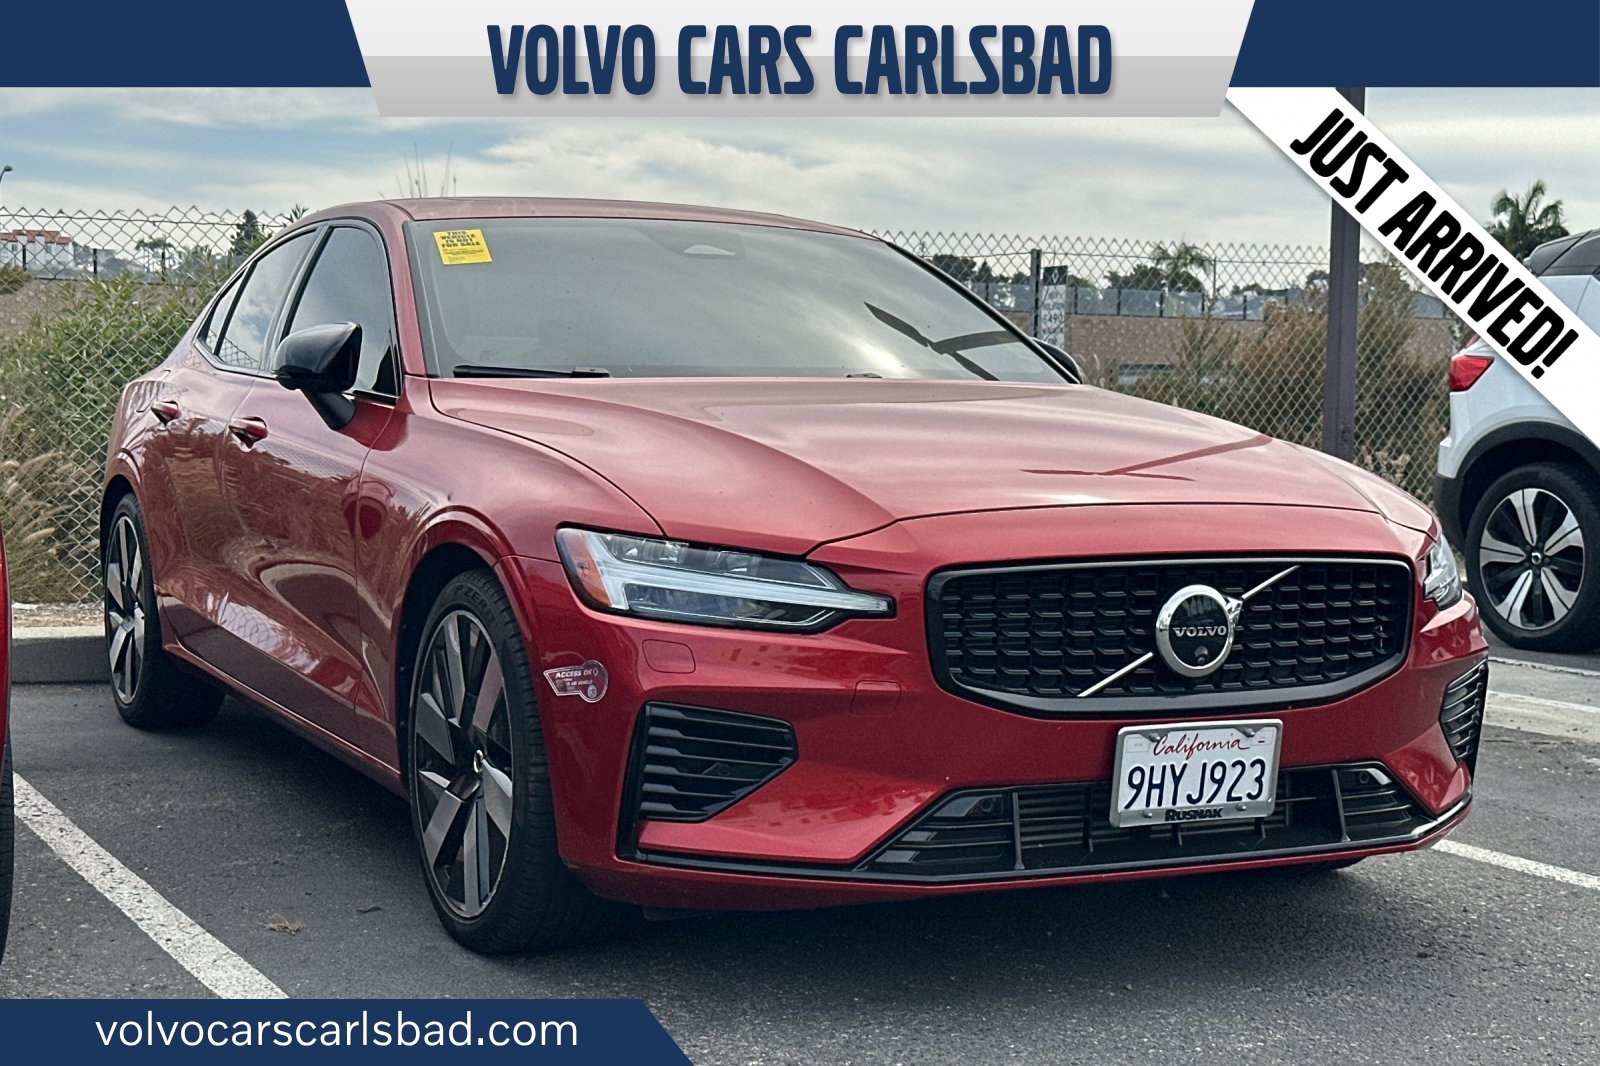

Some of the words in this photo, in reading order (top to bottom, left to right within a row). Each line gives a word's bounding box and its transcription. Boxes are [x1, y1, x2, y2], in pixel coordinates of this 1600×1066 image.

[1172, 625, 1227, 638] VOLVO
[555, 670, 582, 678] ACCESS
[1153, 733, 1251, 761] California
[1124, 759, 1266, 810] 9HYJ923
[1165, 808, 1223, 821] RUSNAK
